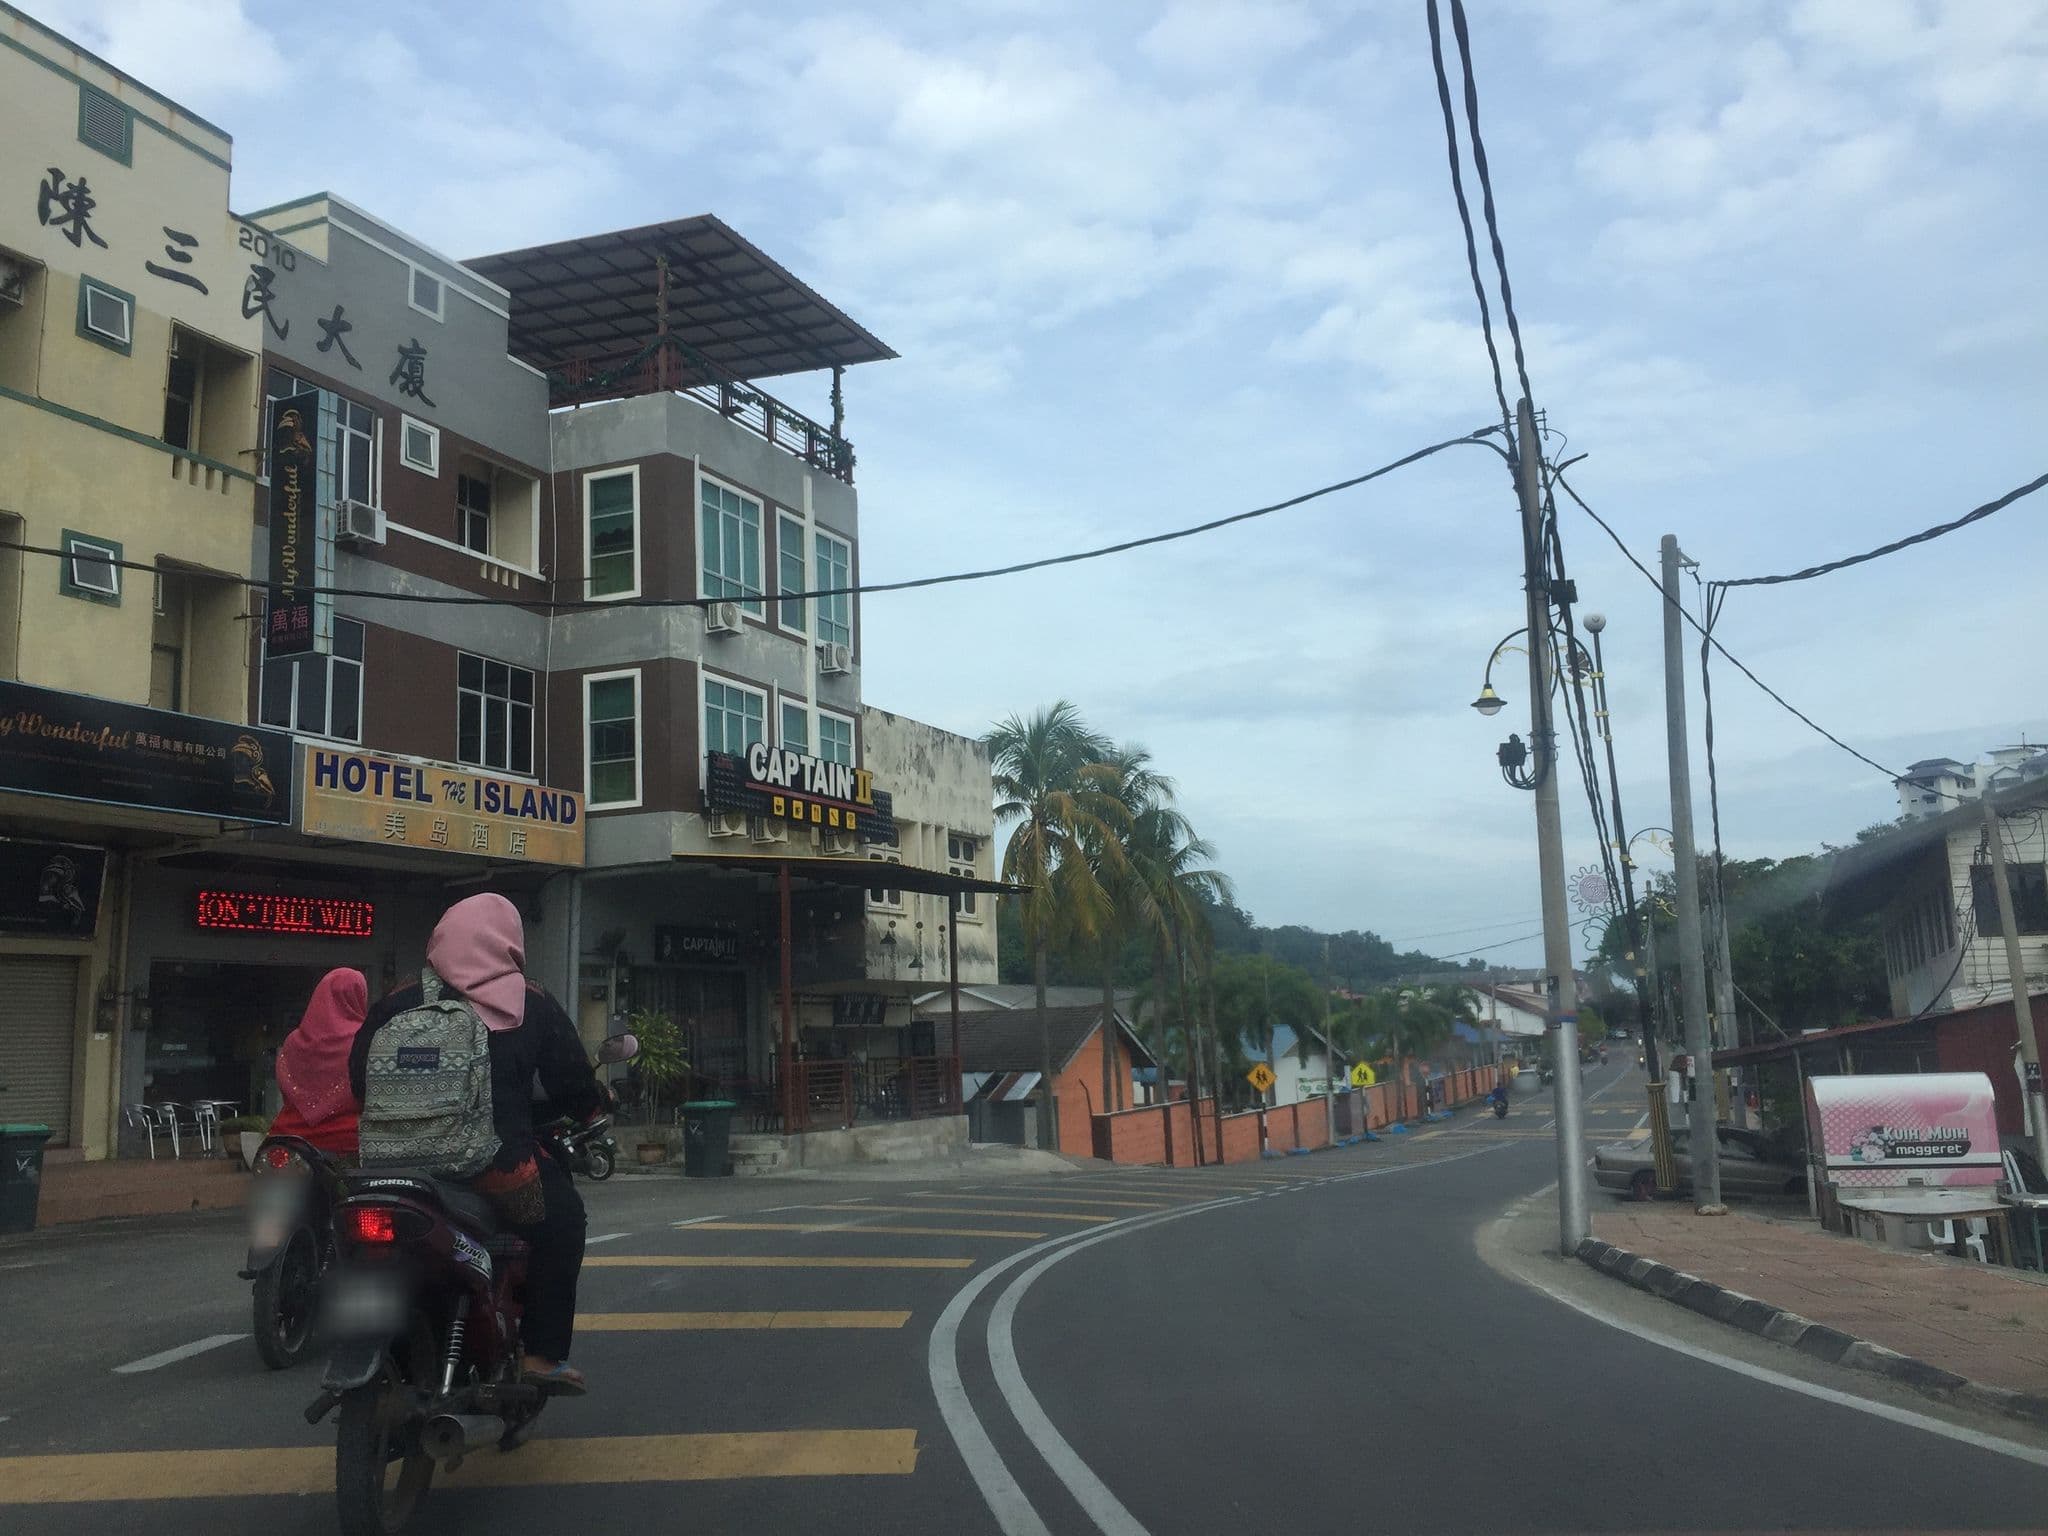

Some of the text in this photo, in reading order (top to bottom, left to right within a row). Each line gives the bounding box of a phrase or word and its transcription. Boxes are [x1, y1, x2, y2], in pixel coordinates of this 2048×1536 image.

[238, 226, 296, 272] 2010
[271, 605, 309, 633] 萬福
[314, 751, 433, 804] HOTEL
[474, 779, 577, 825] ISLAND
[750, 742, 874, 805] CAPTAIN II
[384, 811, 528, 856] 美岛酒店
[369, 1178, 415, 1188] HONDA
[453, 1237, 485, 1260] Wave
